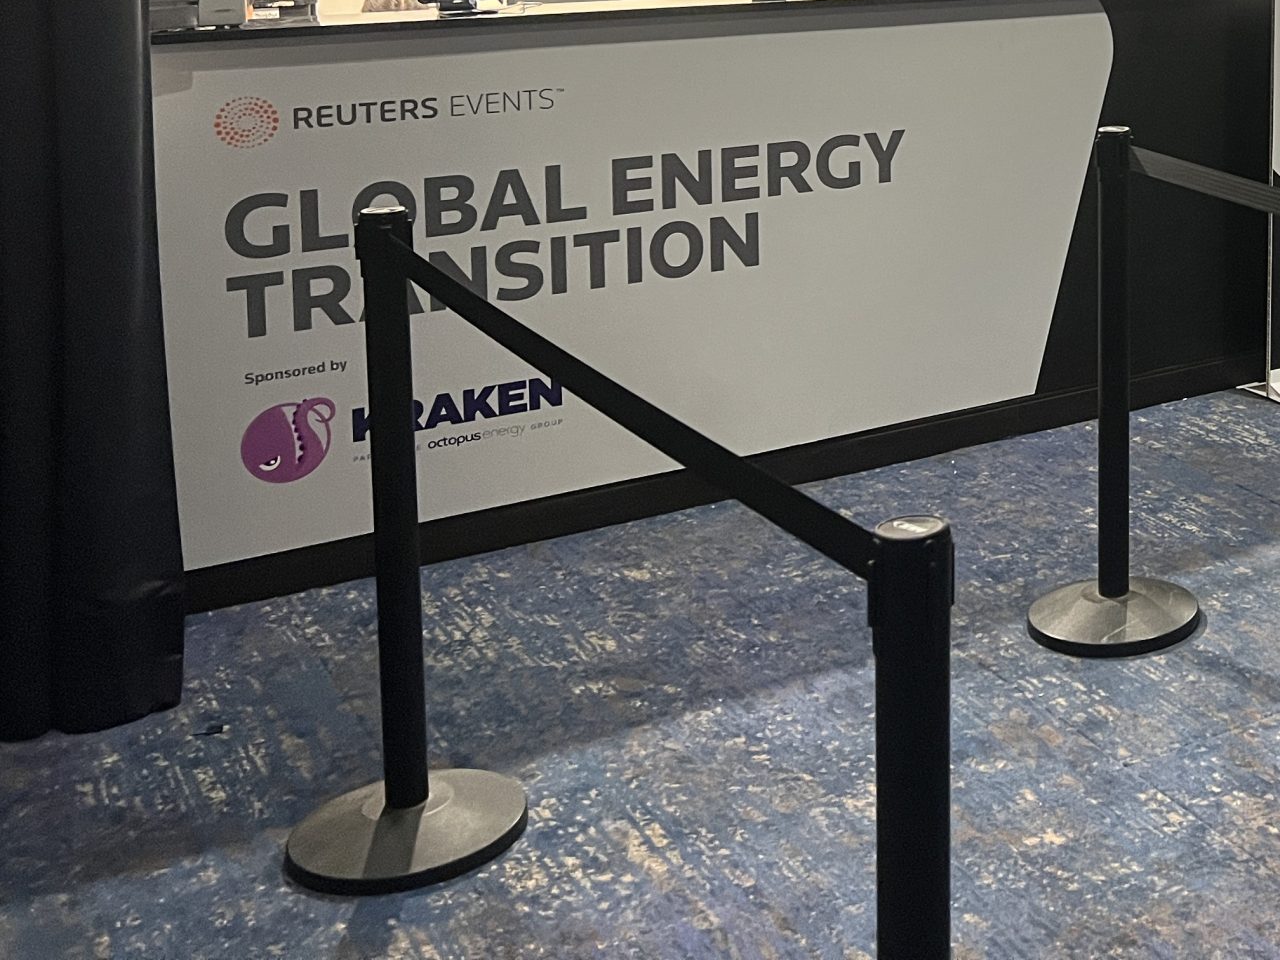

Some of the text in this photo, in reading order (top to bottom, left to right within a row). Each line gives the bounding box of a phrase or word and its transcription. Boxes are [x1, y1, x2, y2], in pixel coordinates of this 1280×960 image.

[293, 97, 439, 130] REUTERS
[611, 128, 906, 218] ENERGY
[244, 359, 347, 386] Sponsored by
[530, 418, 564, 430] GROUP
